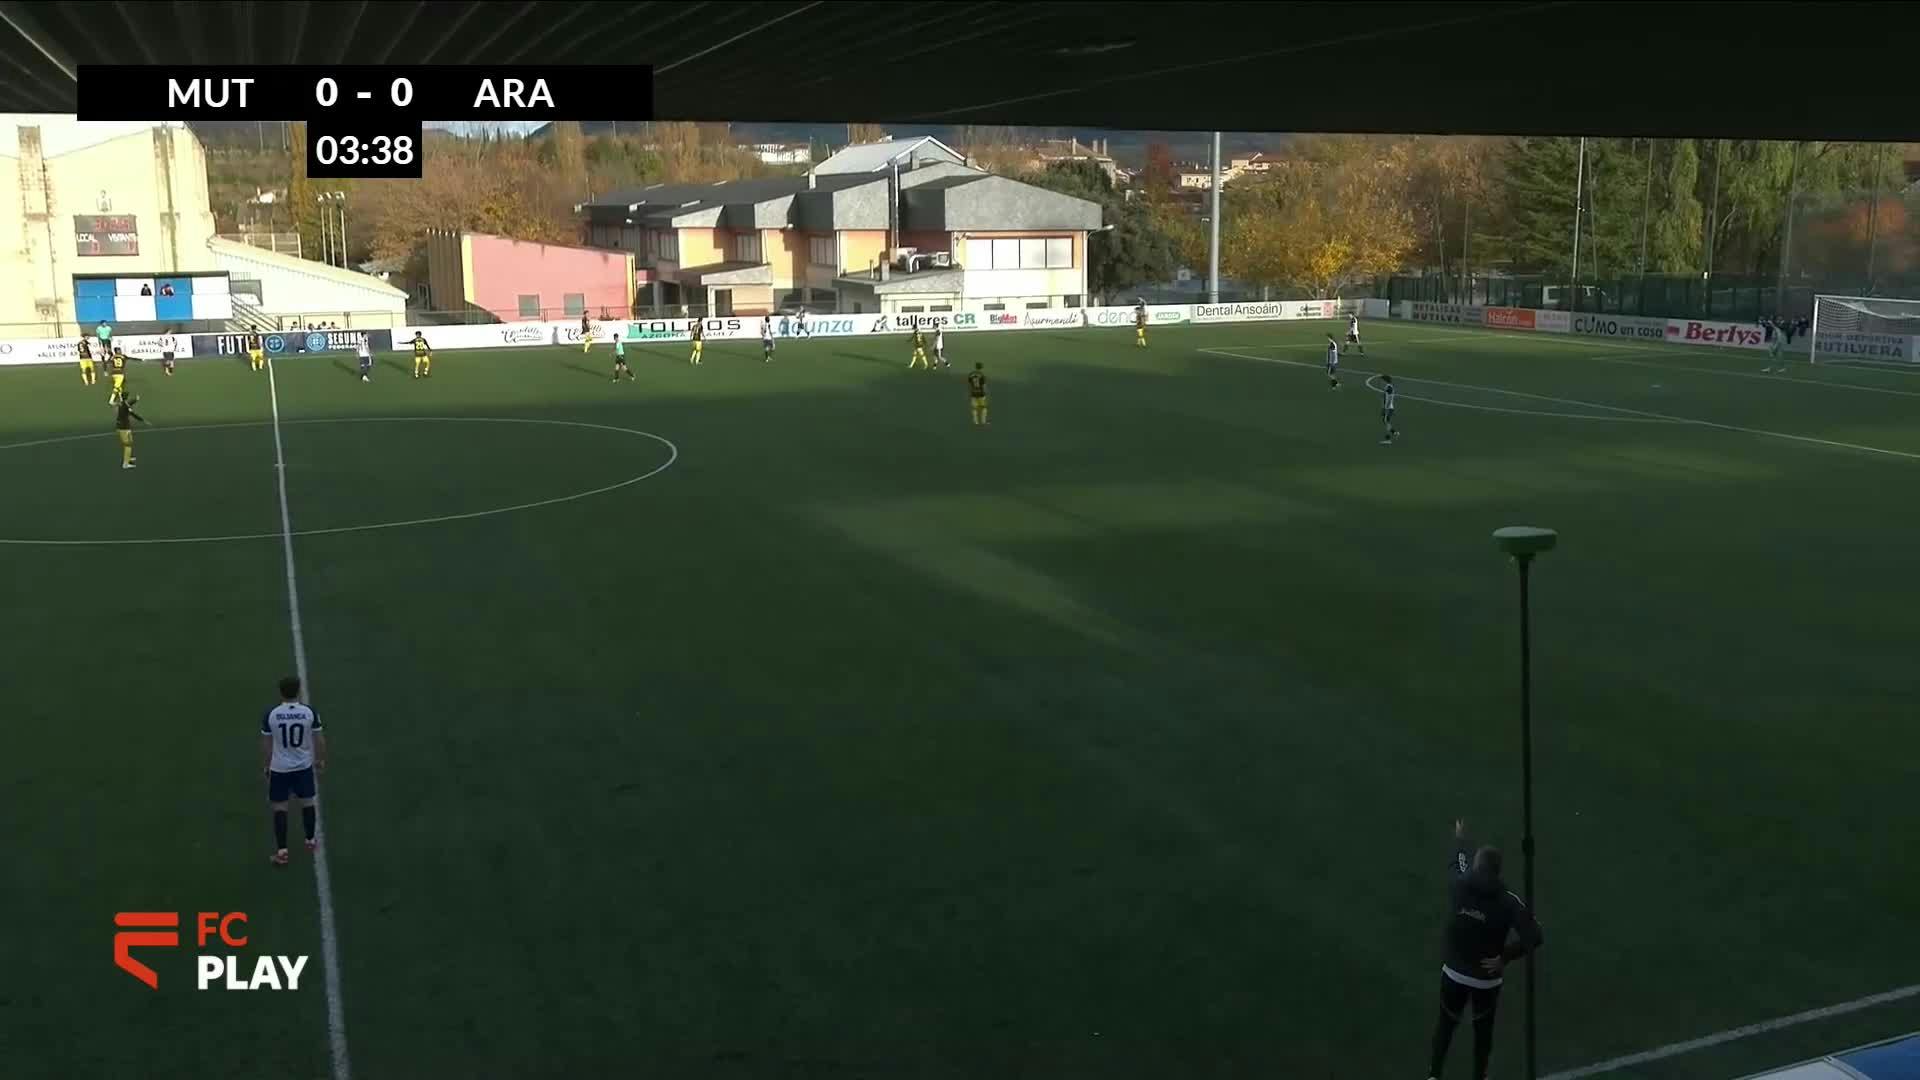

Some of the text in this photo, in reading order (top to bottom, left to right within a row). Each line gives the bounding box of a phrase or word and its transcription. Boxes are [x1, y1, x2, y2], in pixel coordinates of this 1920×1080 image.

[1197, 304, 1233, 317] Dental
[896, 313, 976, 327] talleres CR
[327, 331, 363, 345] SEGUND
[1637, 326, 1663, 338] casa
[1685, 321, 1761, 345] Berlys
[278, 722, 304, 749] 10
